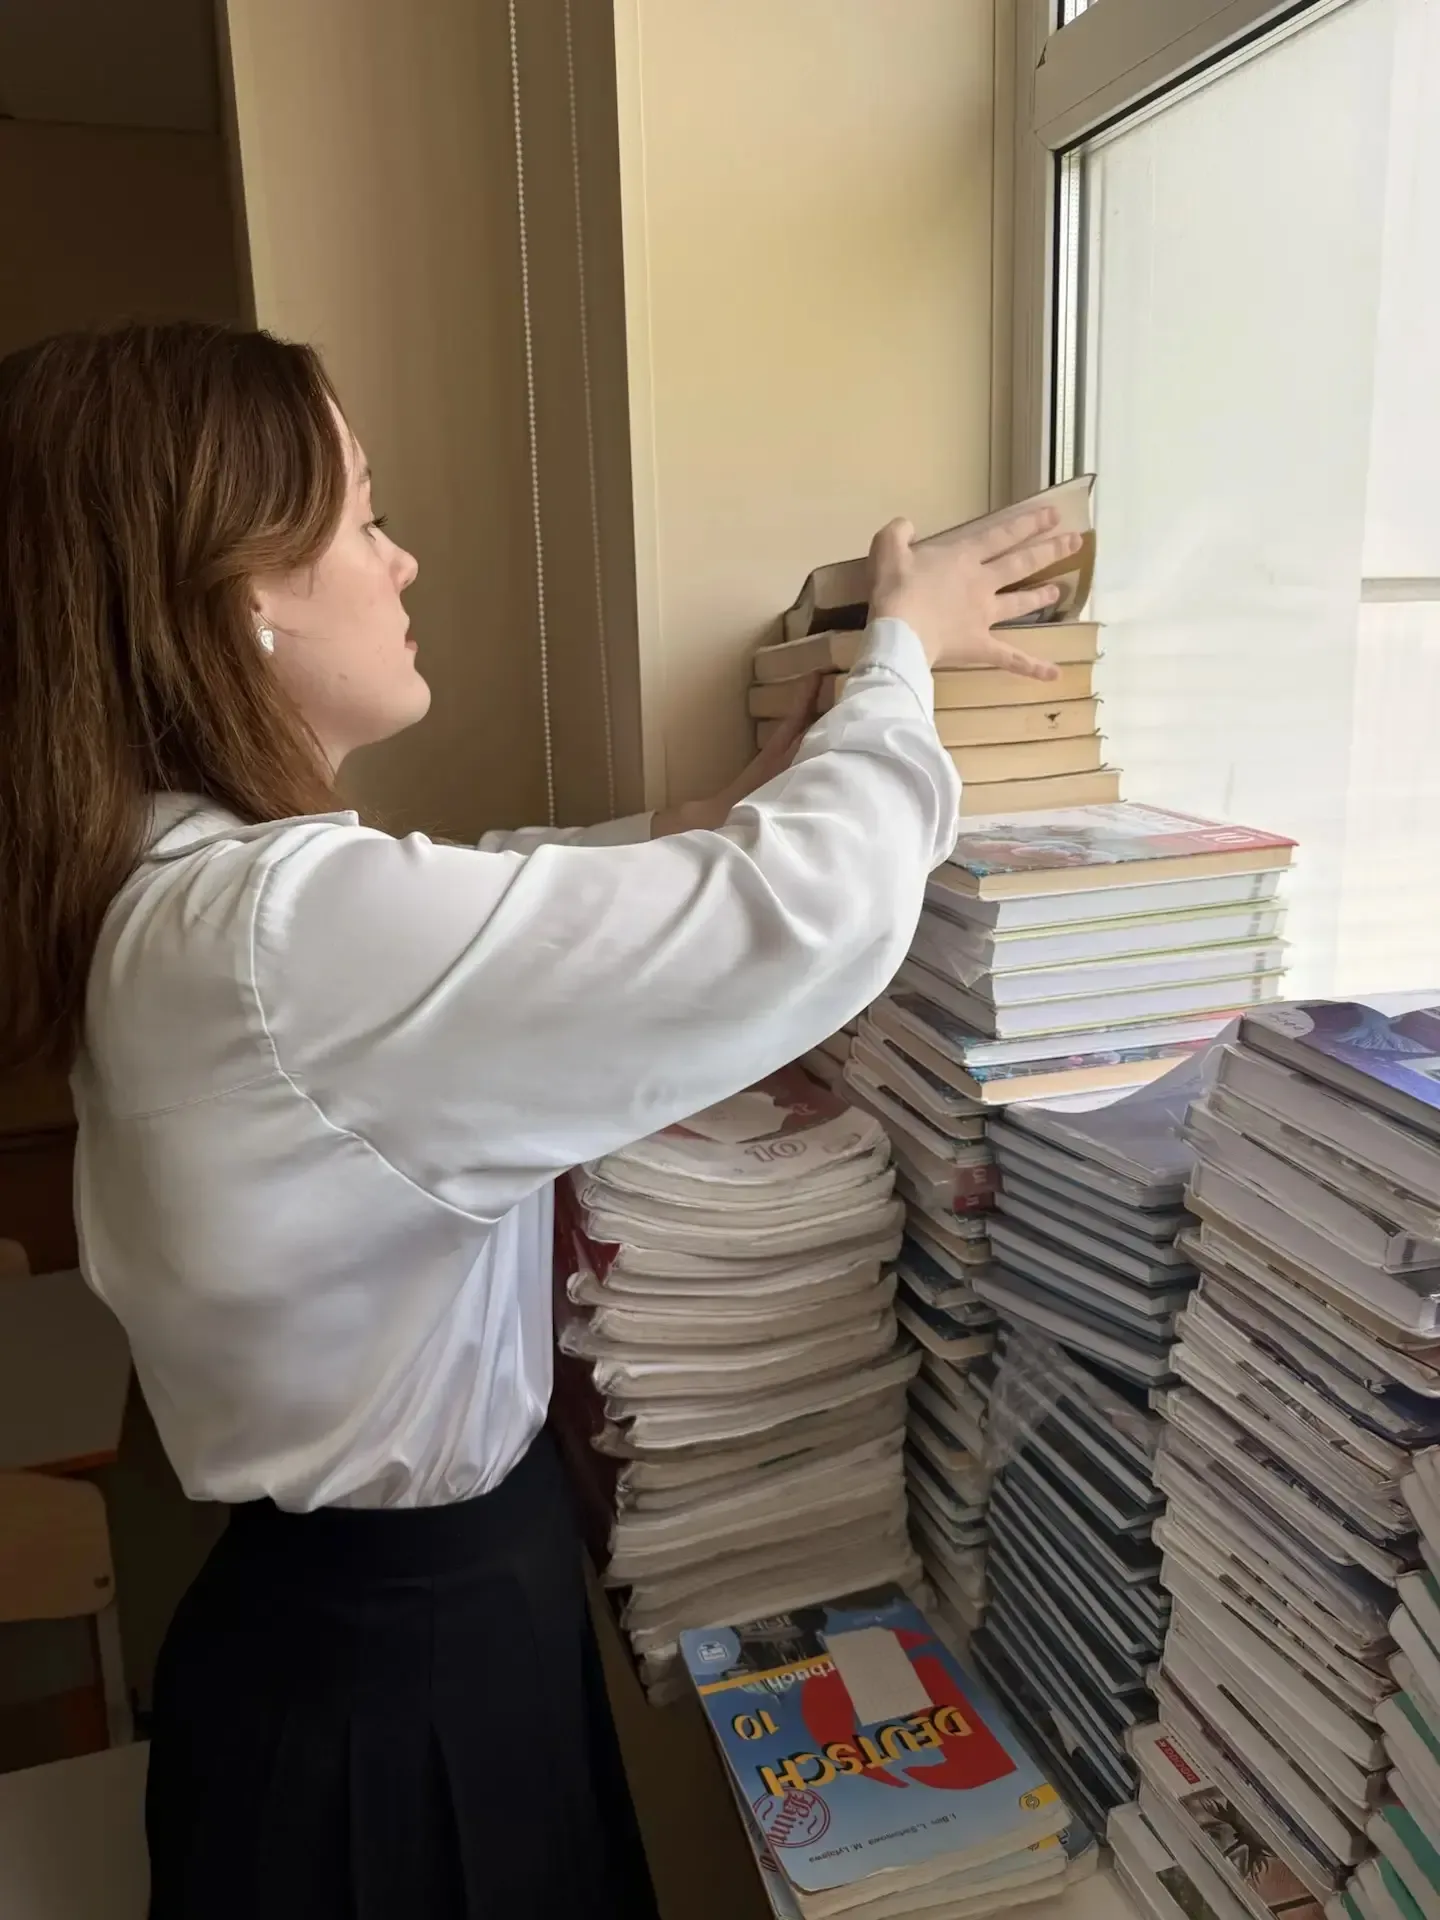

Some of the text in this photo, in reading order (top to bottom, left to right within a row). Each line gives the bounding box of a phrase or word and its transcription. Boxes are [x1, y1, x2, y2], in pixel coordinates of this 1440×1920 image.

[743, 1139, 808, 1164] 10
[768, 1661, 837, 1691] rbuch
[731, 1708, 780, 1741] 10
[758, 1705, 974, 1798] DEUTSCH
